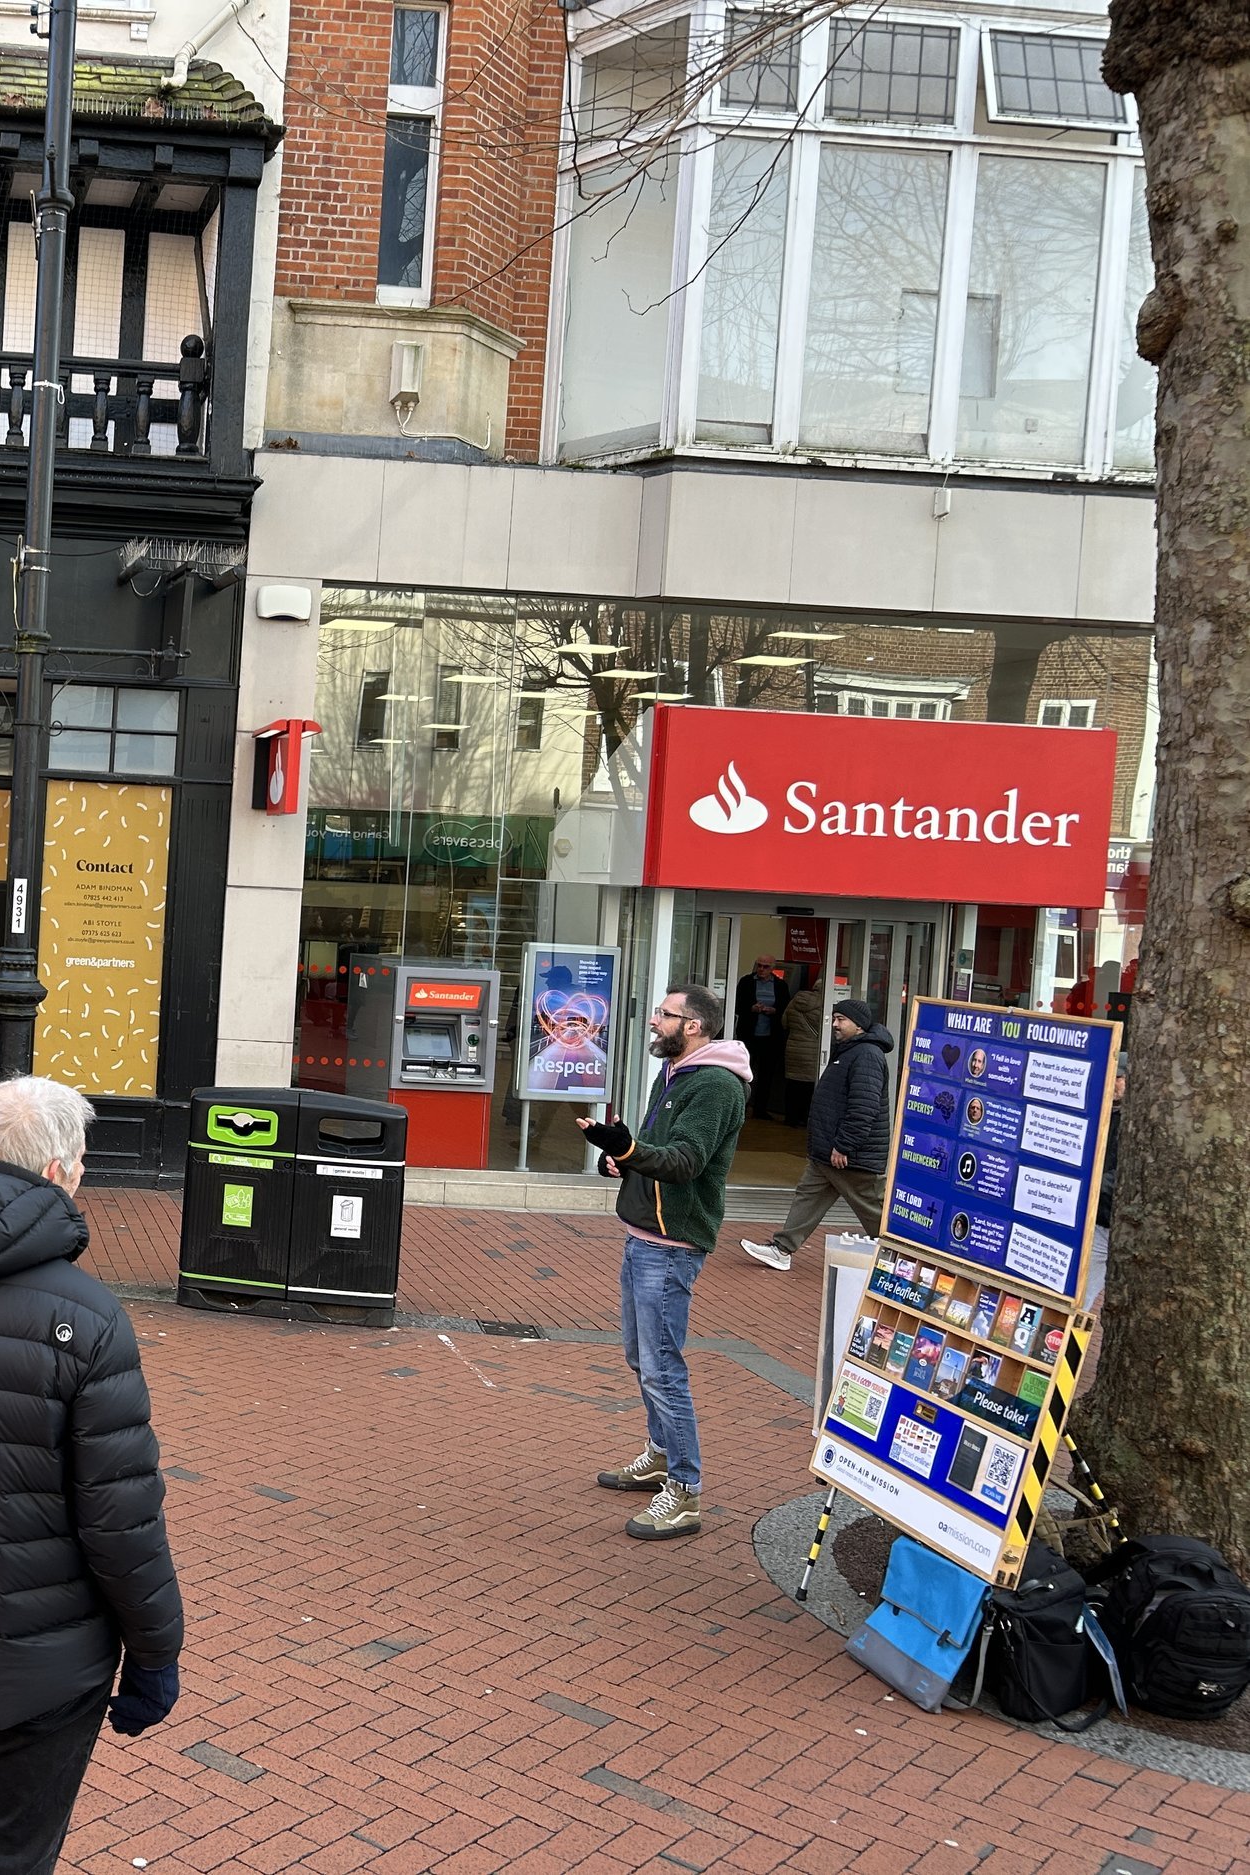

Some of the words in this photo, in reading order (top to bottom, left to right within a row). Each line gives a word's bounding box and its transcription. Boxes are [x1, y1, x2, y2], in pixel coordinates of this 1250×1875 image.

[783, 780, 1080, 848] Santander
[76, 859, 134, 874] Contact
[16, 884, 24, 928] 4931
[65, 956, 135, 969] green&partners
[429, 991, 475, 1001] Santander
[947, 1013, 972, 1031] WHAT
[973, 1018, 992, 1034] ARE
[1001, 1021, 1020, 1039] YOU
[1027, 1024, 1089, 1048] FOLLOWING?
[915, 1036, 931, 1049] YOUR
[533, 1056, 602, 1078] Respect
[912, 1052, 934, 1065] HEART?
[1010, 1057, 1021, 1066] love
[1032, 1059, 1041, 1068] The
[1042, 1060, 1055, 1071] heart
[1060, 1065, 1086, 1076] deceitful
[1030, 1071, 1045, 1080] above
[1053, 1074, 1070, 1086] things,
[1071, 1079, 1082, 1088] and
[910, 1084, 921, 1097] THE
[1029, 1083, 1059, 1096] desperately
[1059, 1088, 1080, 1100] wicked.
[907, 1100, 934, 1116] EXPERTS?
[1031, 1110, 1040, 1119] You
[1056, 1116, 1069, 1126] know
[1070, 1120, 1083, 1130] what
[1025, 1128, 1033, 1136] For
[1033, 1129, 1045, 1139] what
[1049, 1135, 1061, 1145] your
[1061, 1137, 1072, 1147] life?
[1030, 1120, 1038, 1128] will
[1038, 1122, 1054, 1133] happen
[1055, 1127, 1080, 1140] tomorrow.
[904, 1134, 915, 1147] THE
[1033, 1141, 1044, 1149] even
[902, 1149, 940, 1169] INFLUENCERS?
[1024, 1174, 1041, 1185] Charm
[1047, 1179, 1072, 1193] deceitful
[896, 1188, 907, 1202] THE
[907, 1192, 922, 1208] LORD
[1027, 1188, 1038, 1197] and
[1038, 1191, 1057, 1203] beauty
[893, 1204, 908, 1219] JESUS
[909, 1209, 933, 1230] CHRIST?
[1014, 1229, 1027, 1240] Jesus
[1050, 1243, 1058, 1253] the
[1010, 1247, 1019, 1255] one
[1019, 1251, 1034, 1262] comes
[1035, 1256, 1041, 1264] to
[1041, 1259, 1049, 1268] the
[1049, 1263, 1065, 1276] Father
[1012, 1238, 1020, 1246] the
[1020, 1241, 1031, 1251] truth
[1032, 1247, 1042, 1257] and
[1042, 1251, 1050, 1259] the
[1051, 1254, 1060, 1264] life.
[1060, 1259, 1067, 1268] No
[1014, 1259, 1029, 1271] except
[1029, 1265, 1049, 1280] through
[877, 1276, 894, 1292] Free
[893, 1282, 922, 1303] leaflets
[1020, 1307, 1037, 1325] A
[1014, 1328, 1030, 1349] Q
[859, 1377, 871, 1387] GOOD
[974, 1391, 1003, 1414] Please
[1003, 1406, 1030, 1428] take!
[839, 1455, 869, 1478] OPEN-AIR
[871, 1475, 900, 1496] MISSION
[938, 1521, 991, 1557] oamission.com
